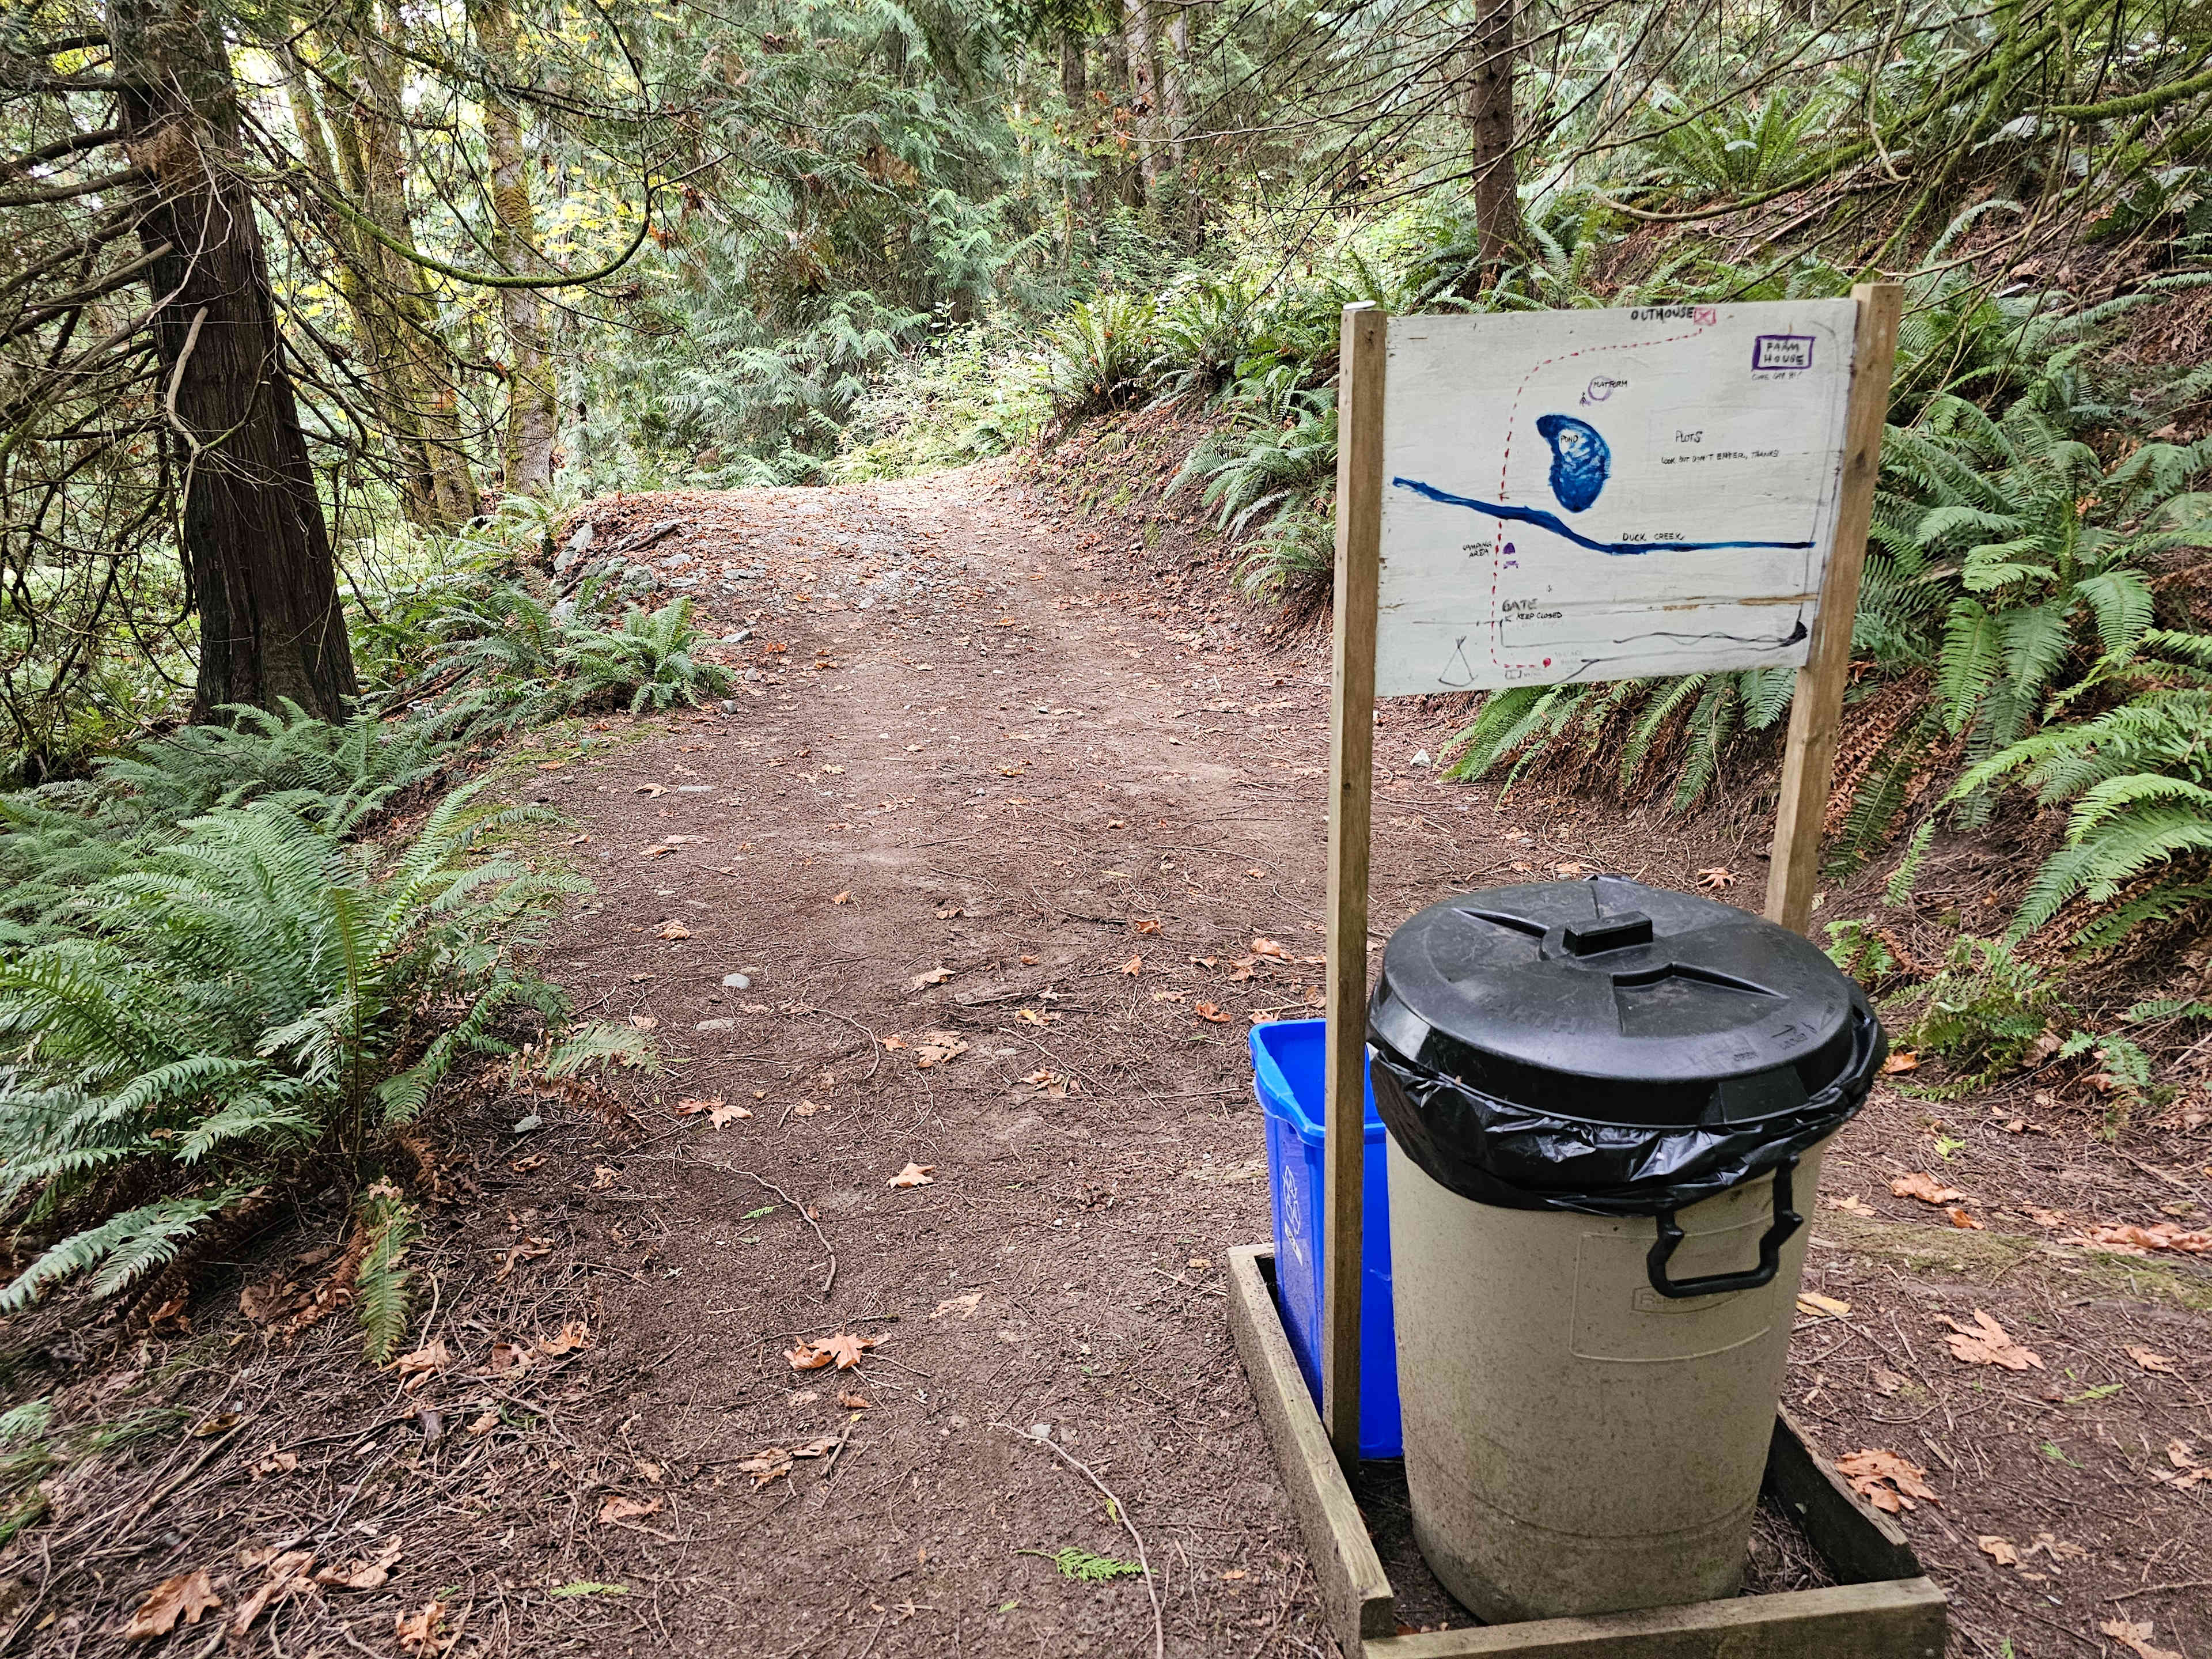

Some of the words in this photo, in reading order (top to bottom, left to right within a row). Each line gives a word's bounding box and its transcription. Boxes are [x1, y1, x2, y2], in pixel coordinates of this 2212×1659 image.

[1631, 307, 1695, 321] OUTHOUSE
[1766, 342, 1799, 352] FARM
[1764, 354, 1804, 365] HOUSE
[1560, 435, 1578, 443] POND
[1675, 431, 1703, 442] PLOTS
[1623, 532, 1646, 541] DUCK
[1502, 599, 1537, 611] GATE
